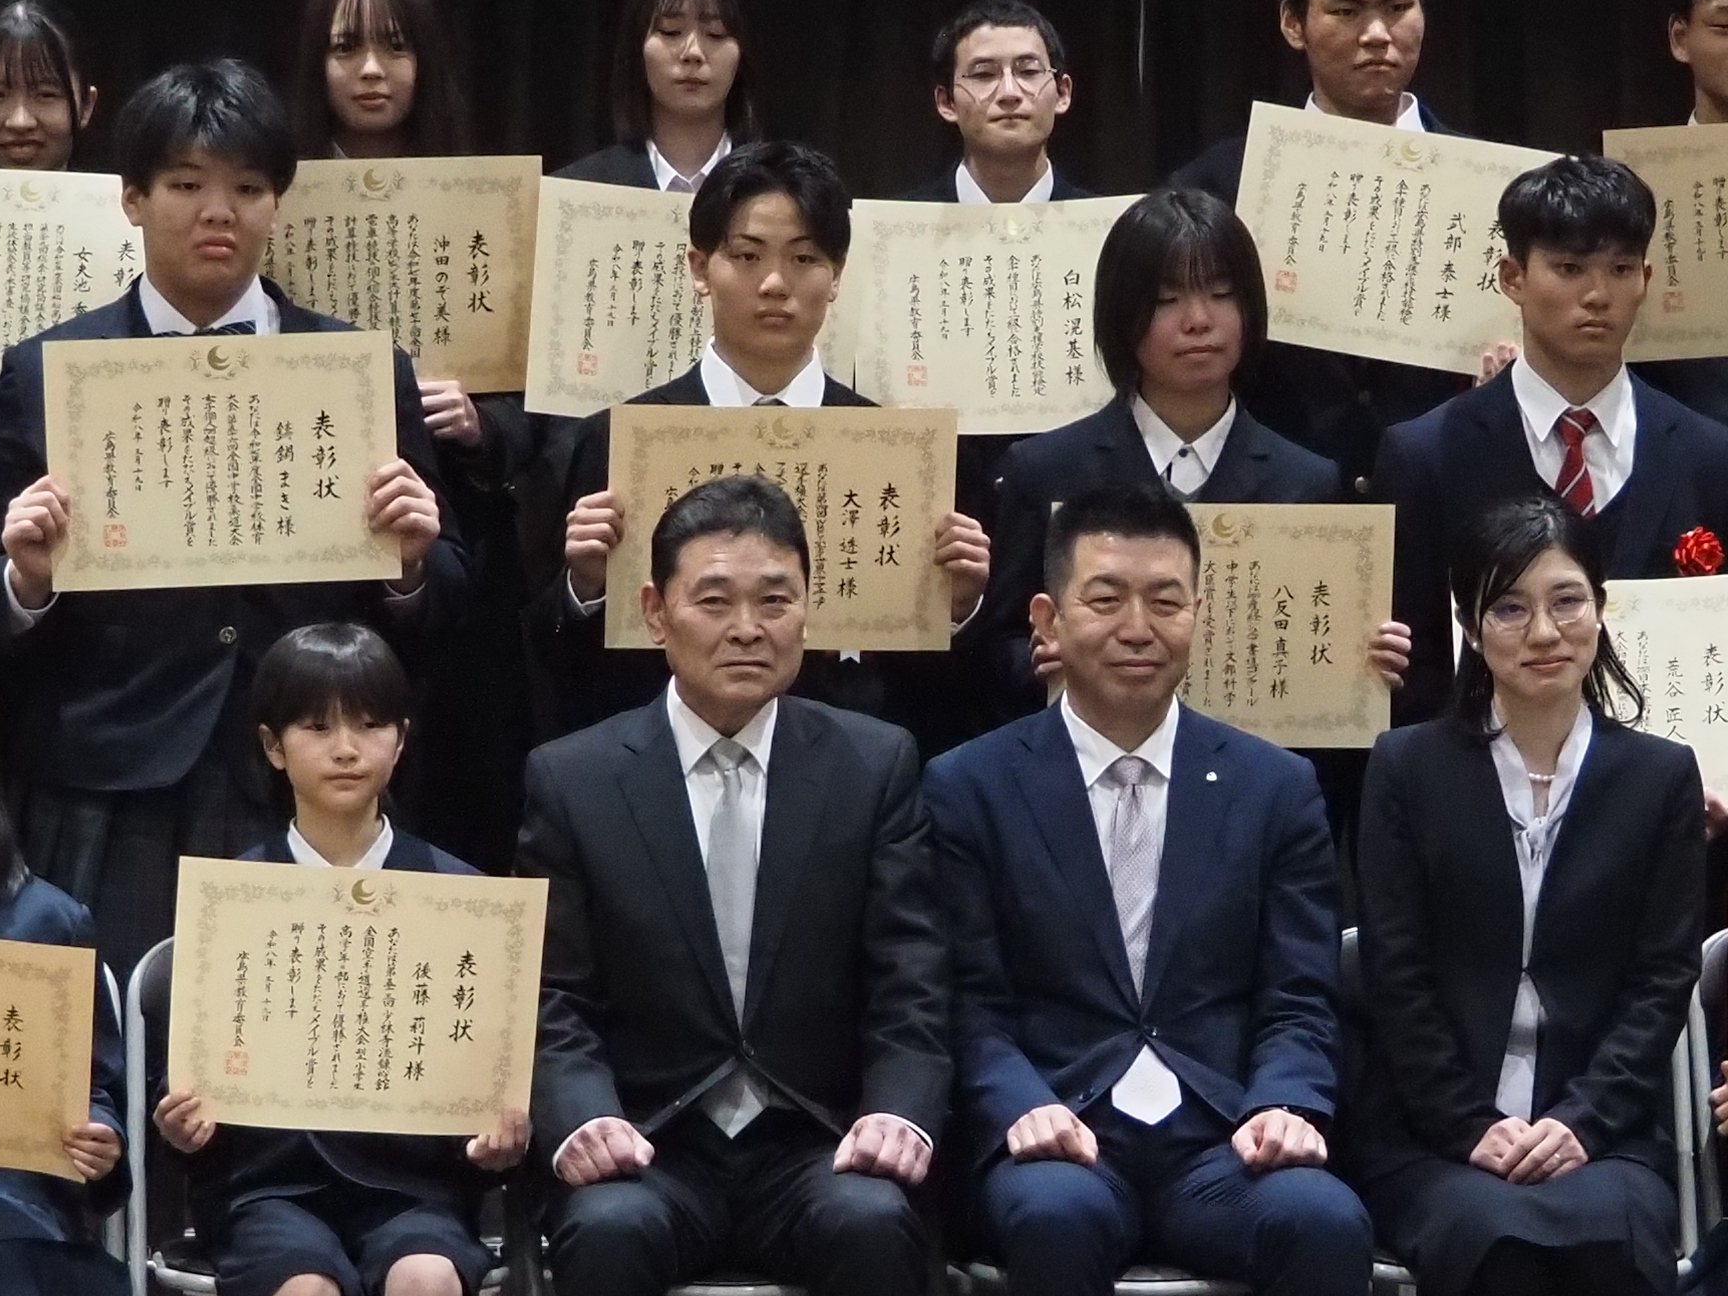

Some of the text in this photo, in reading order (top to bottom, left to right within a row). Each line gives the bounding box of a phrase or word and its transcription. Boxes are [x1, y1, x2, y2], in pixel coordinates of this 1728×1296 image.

[466, 230, 494, 313] 表彰状
[311, 409, 341, 499] 表彰状
[874, 482, 901, 566] 表彰状
[1270, 585, 1294, 699] 八反田真子様
[1310, 580, 1333, 665] 表彰状
[404, 962, 432, 1081] 後藤莉斗様
[449, 950, 477, 1043] 表彰状
